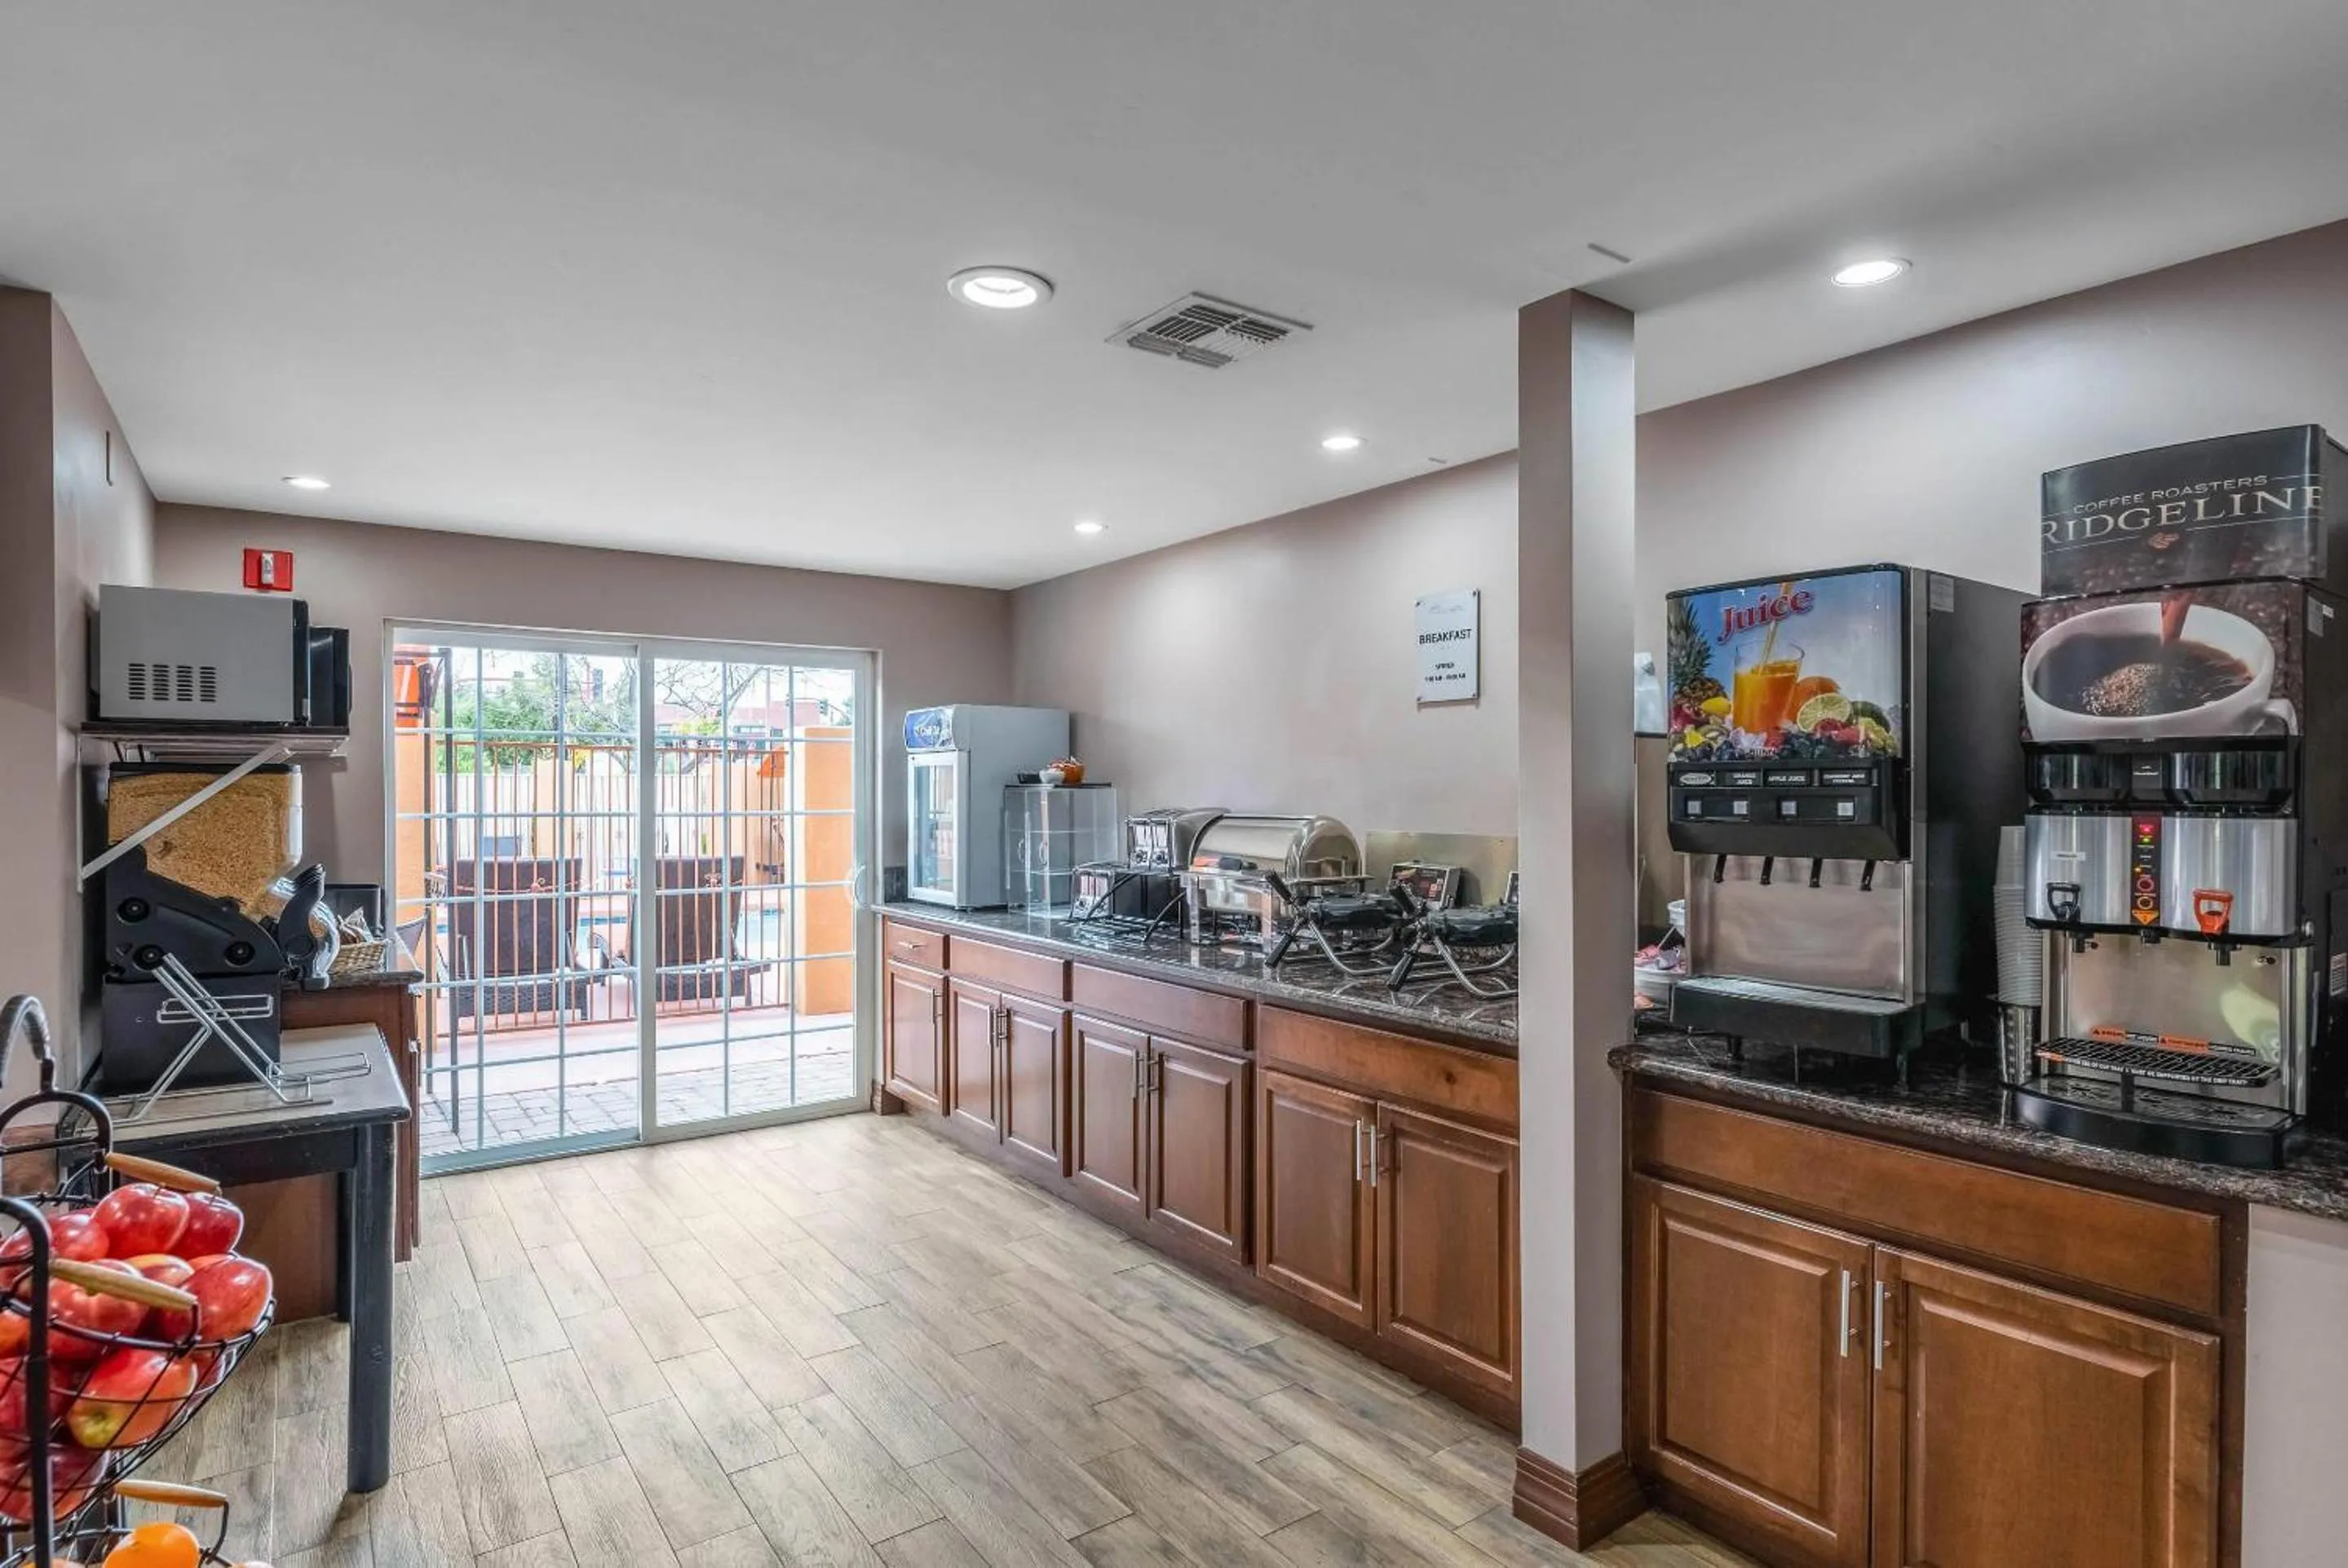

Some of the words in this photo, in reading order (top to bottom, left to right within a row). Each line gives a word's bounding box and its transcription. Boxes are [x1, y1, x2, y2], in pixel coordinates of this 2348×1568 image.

[2041, 486, 2324, 544] RIDGELINE
[2073, 492, 2145, 514] COFFEE
[2151, 475, 2267, 501] ROASTERS
[1419, 629, 1471, 644] BREAKFAST
[1717, 590, 1814, 644] Juice
